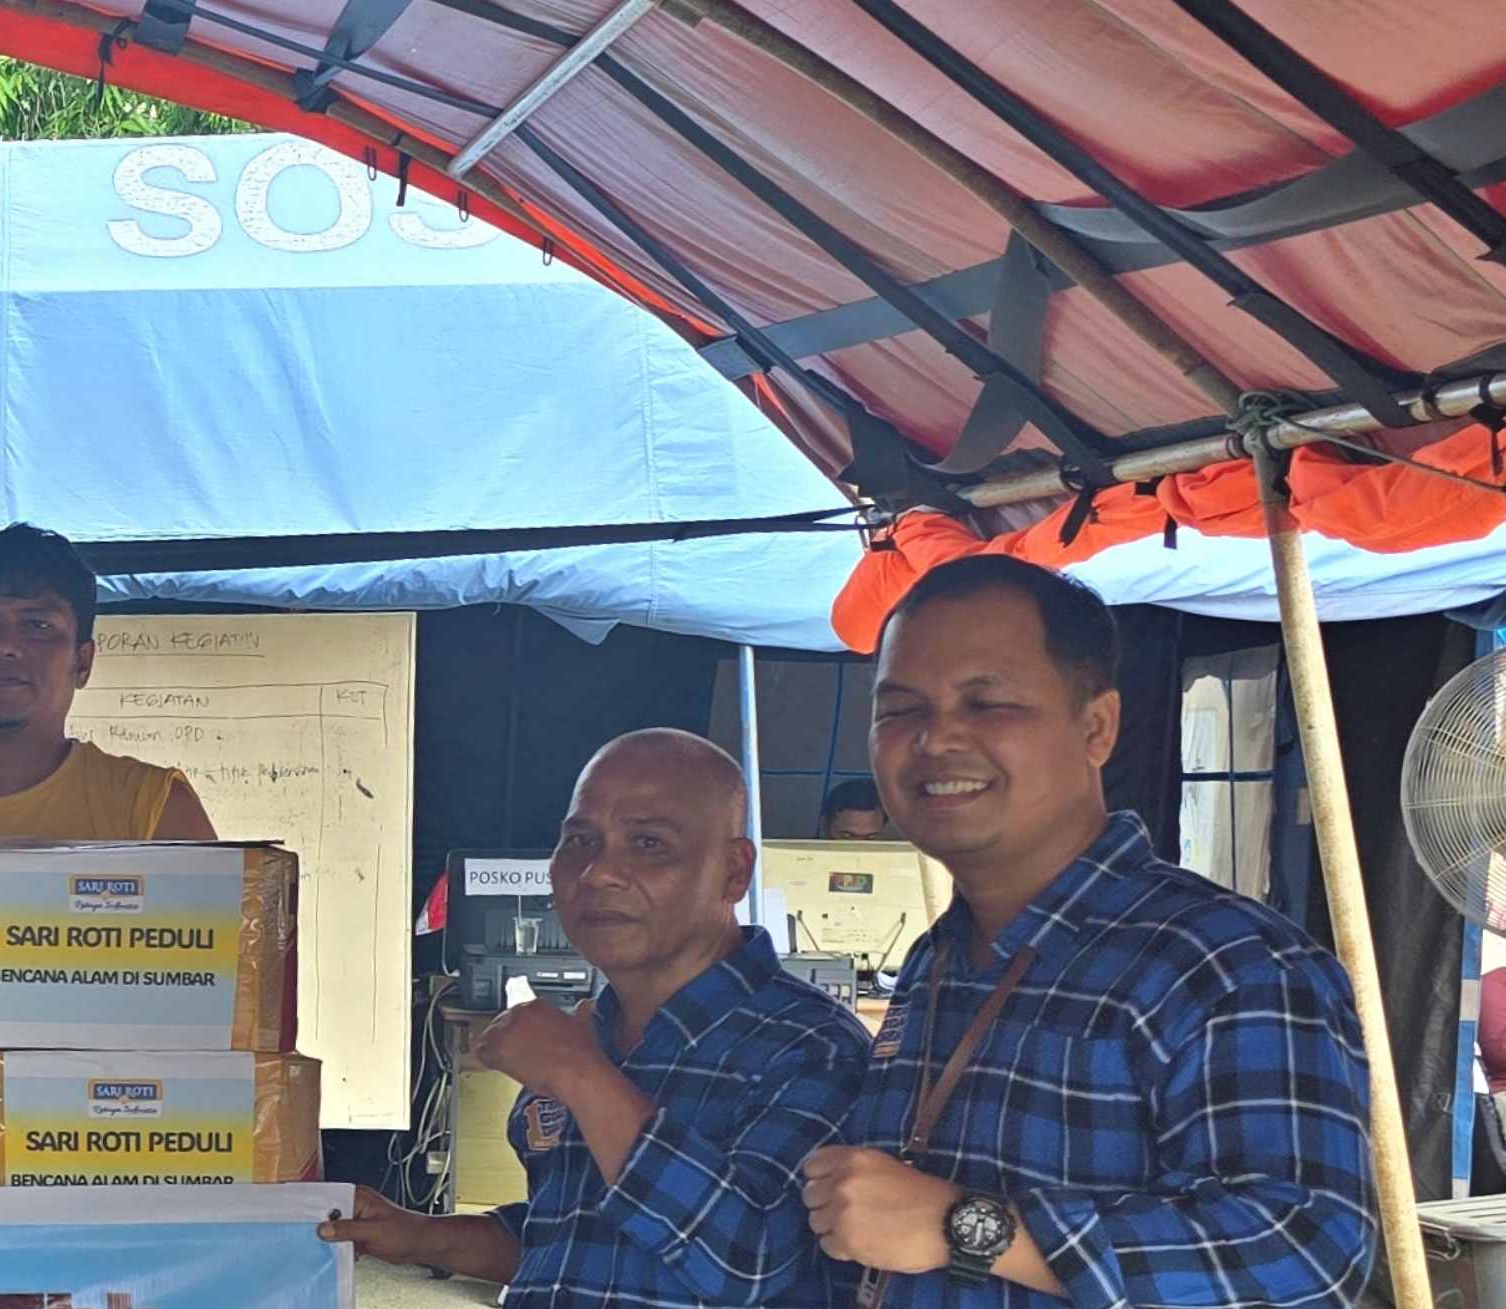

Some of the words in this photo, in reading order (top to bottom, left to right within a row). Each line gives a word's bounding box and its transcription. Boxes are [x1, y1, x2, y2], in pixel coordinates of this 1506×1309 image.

[97, 632, 160, 650] PORAN
[470, 871, 522, 885] POSKO
[6, 925, 59, 946] SARI
[66, 926, 122, 947] ROTI
[129, 927, 213, 949] PEDULI
[70, 970, 118, 984] ALAM
[122, 971, 139, 985] DI
[142, 971, 215, 986] SUMBAR
